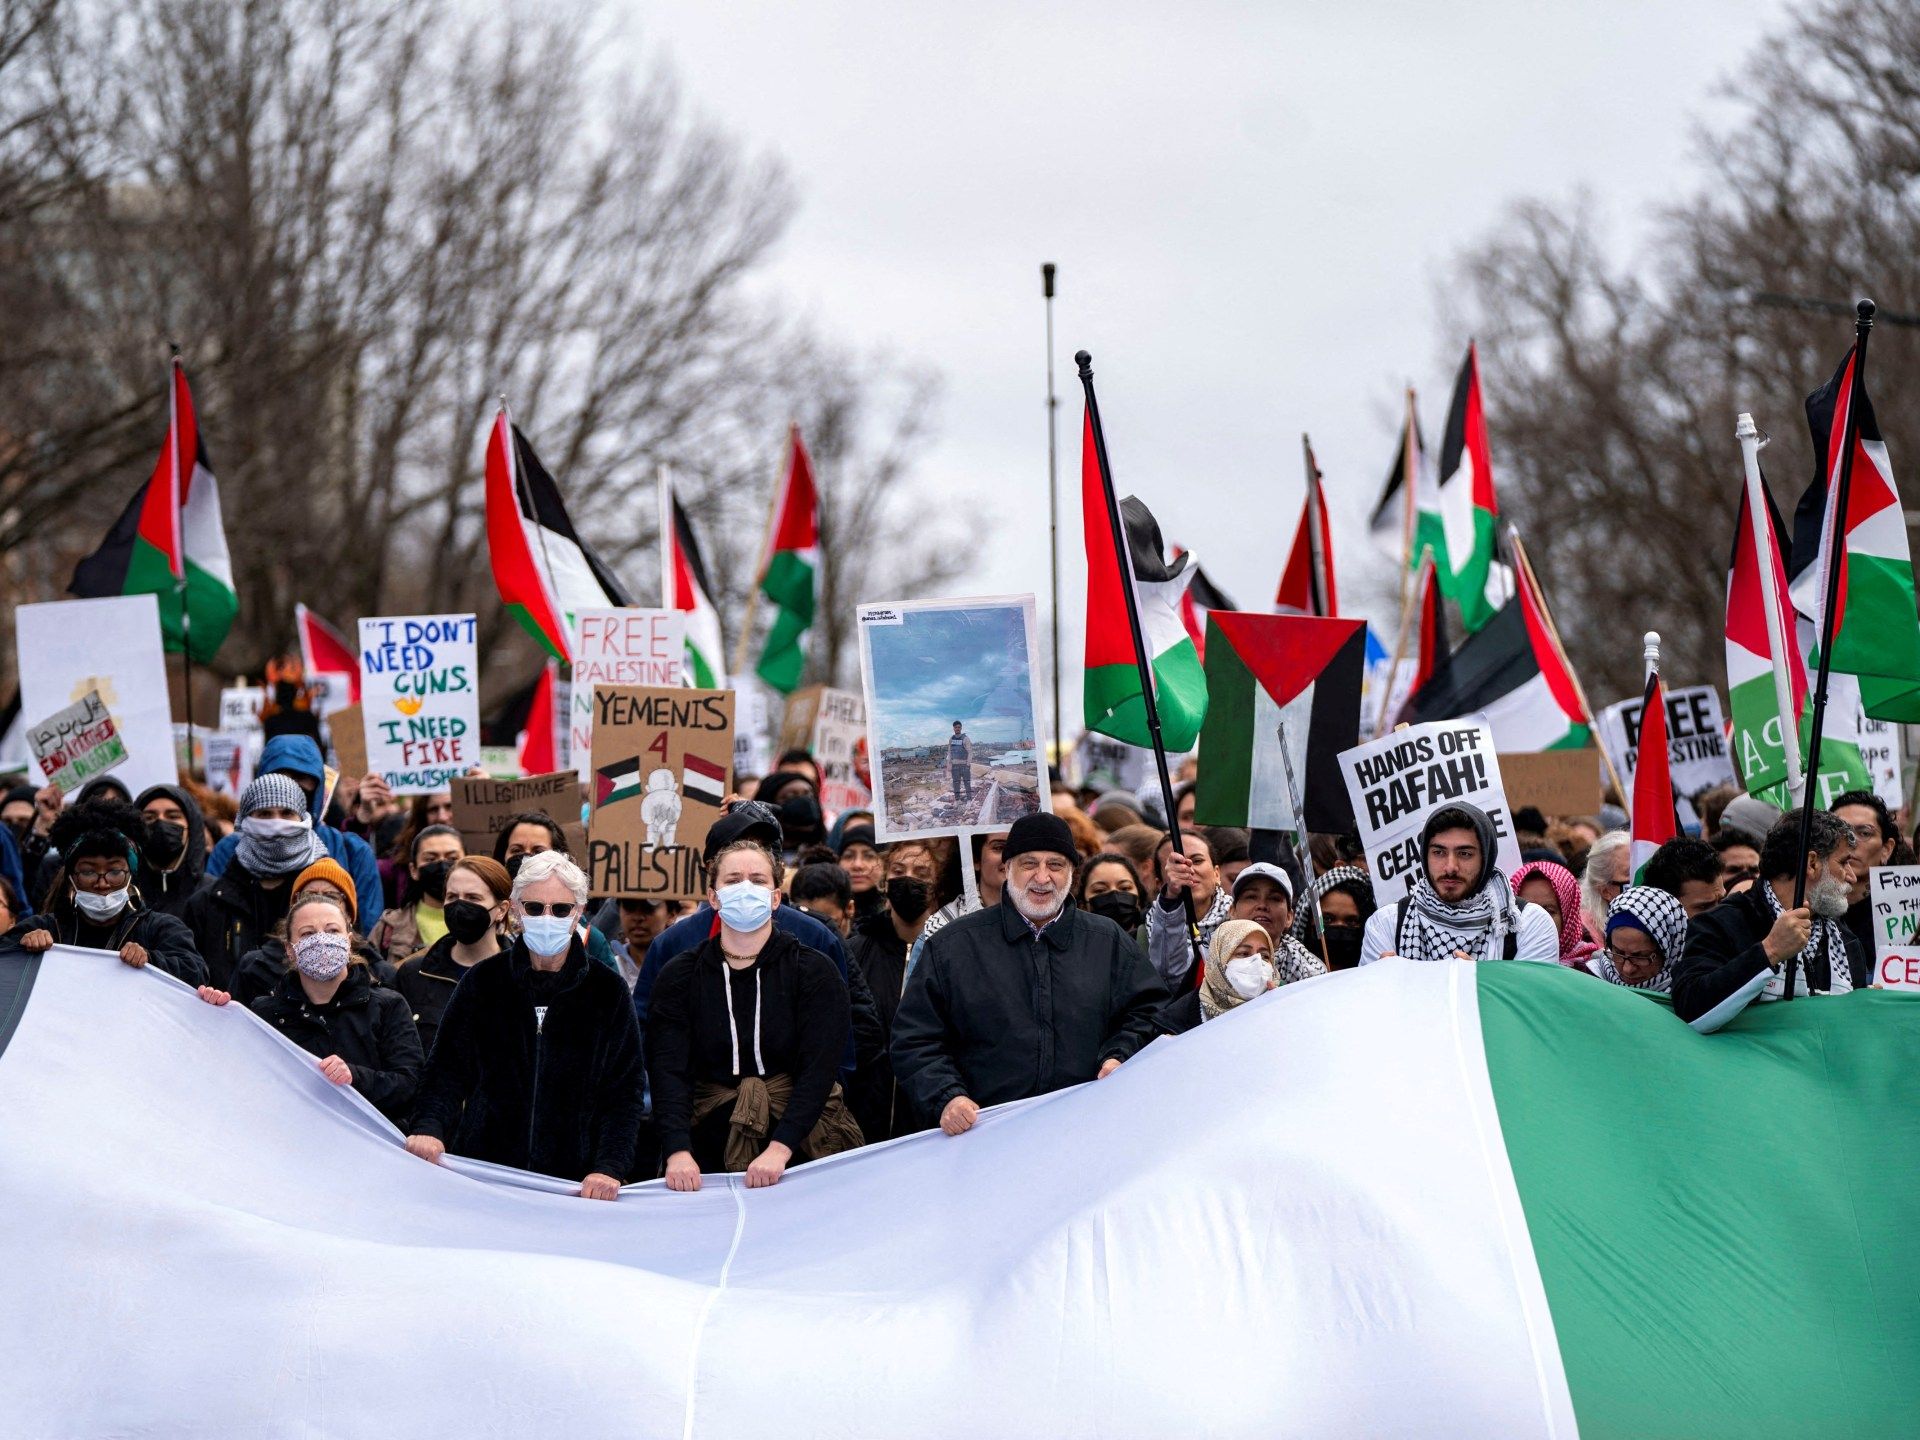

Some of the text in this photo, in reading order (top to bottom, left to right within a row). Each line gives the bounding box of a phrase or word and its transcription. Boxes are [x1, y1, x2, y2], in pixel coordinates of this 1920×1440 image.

[581, 616, 669, 658] FREE
[364, 644, 434, 673] NEED
[576, 660, 680, 685] PALESTINE
[394, 666, 471, 695] GUNS.
[595, 691, 728, 731] YEMENIS
[1621, 693, 1715, 748] FEE
[378, 717, 467, 744] I NEED
[403, 738, 463, 766] FIRE
[648, 731, 668, 763] 4
[1354, 728, 1481, 789] HANDS OFF
[1625, 735, 1726, 773] PSTINE
[1860, 747, 1889, 769] ope
[39, 749, 67, 776] END
[464, 777, 565, 805] ILLEGITIMATE
[1364, 753, 1489, 831] RAFAH!
[587, 840, 709, 896] PALESTIN
[1875, 898, 1920, 915] TO TH
[1881, 955, 1920, 984] CE
